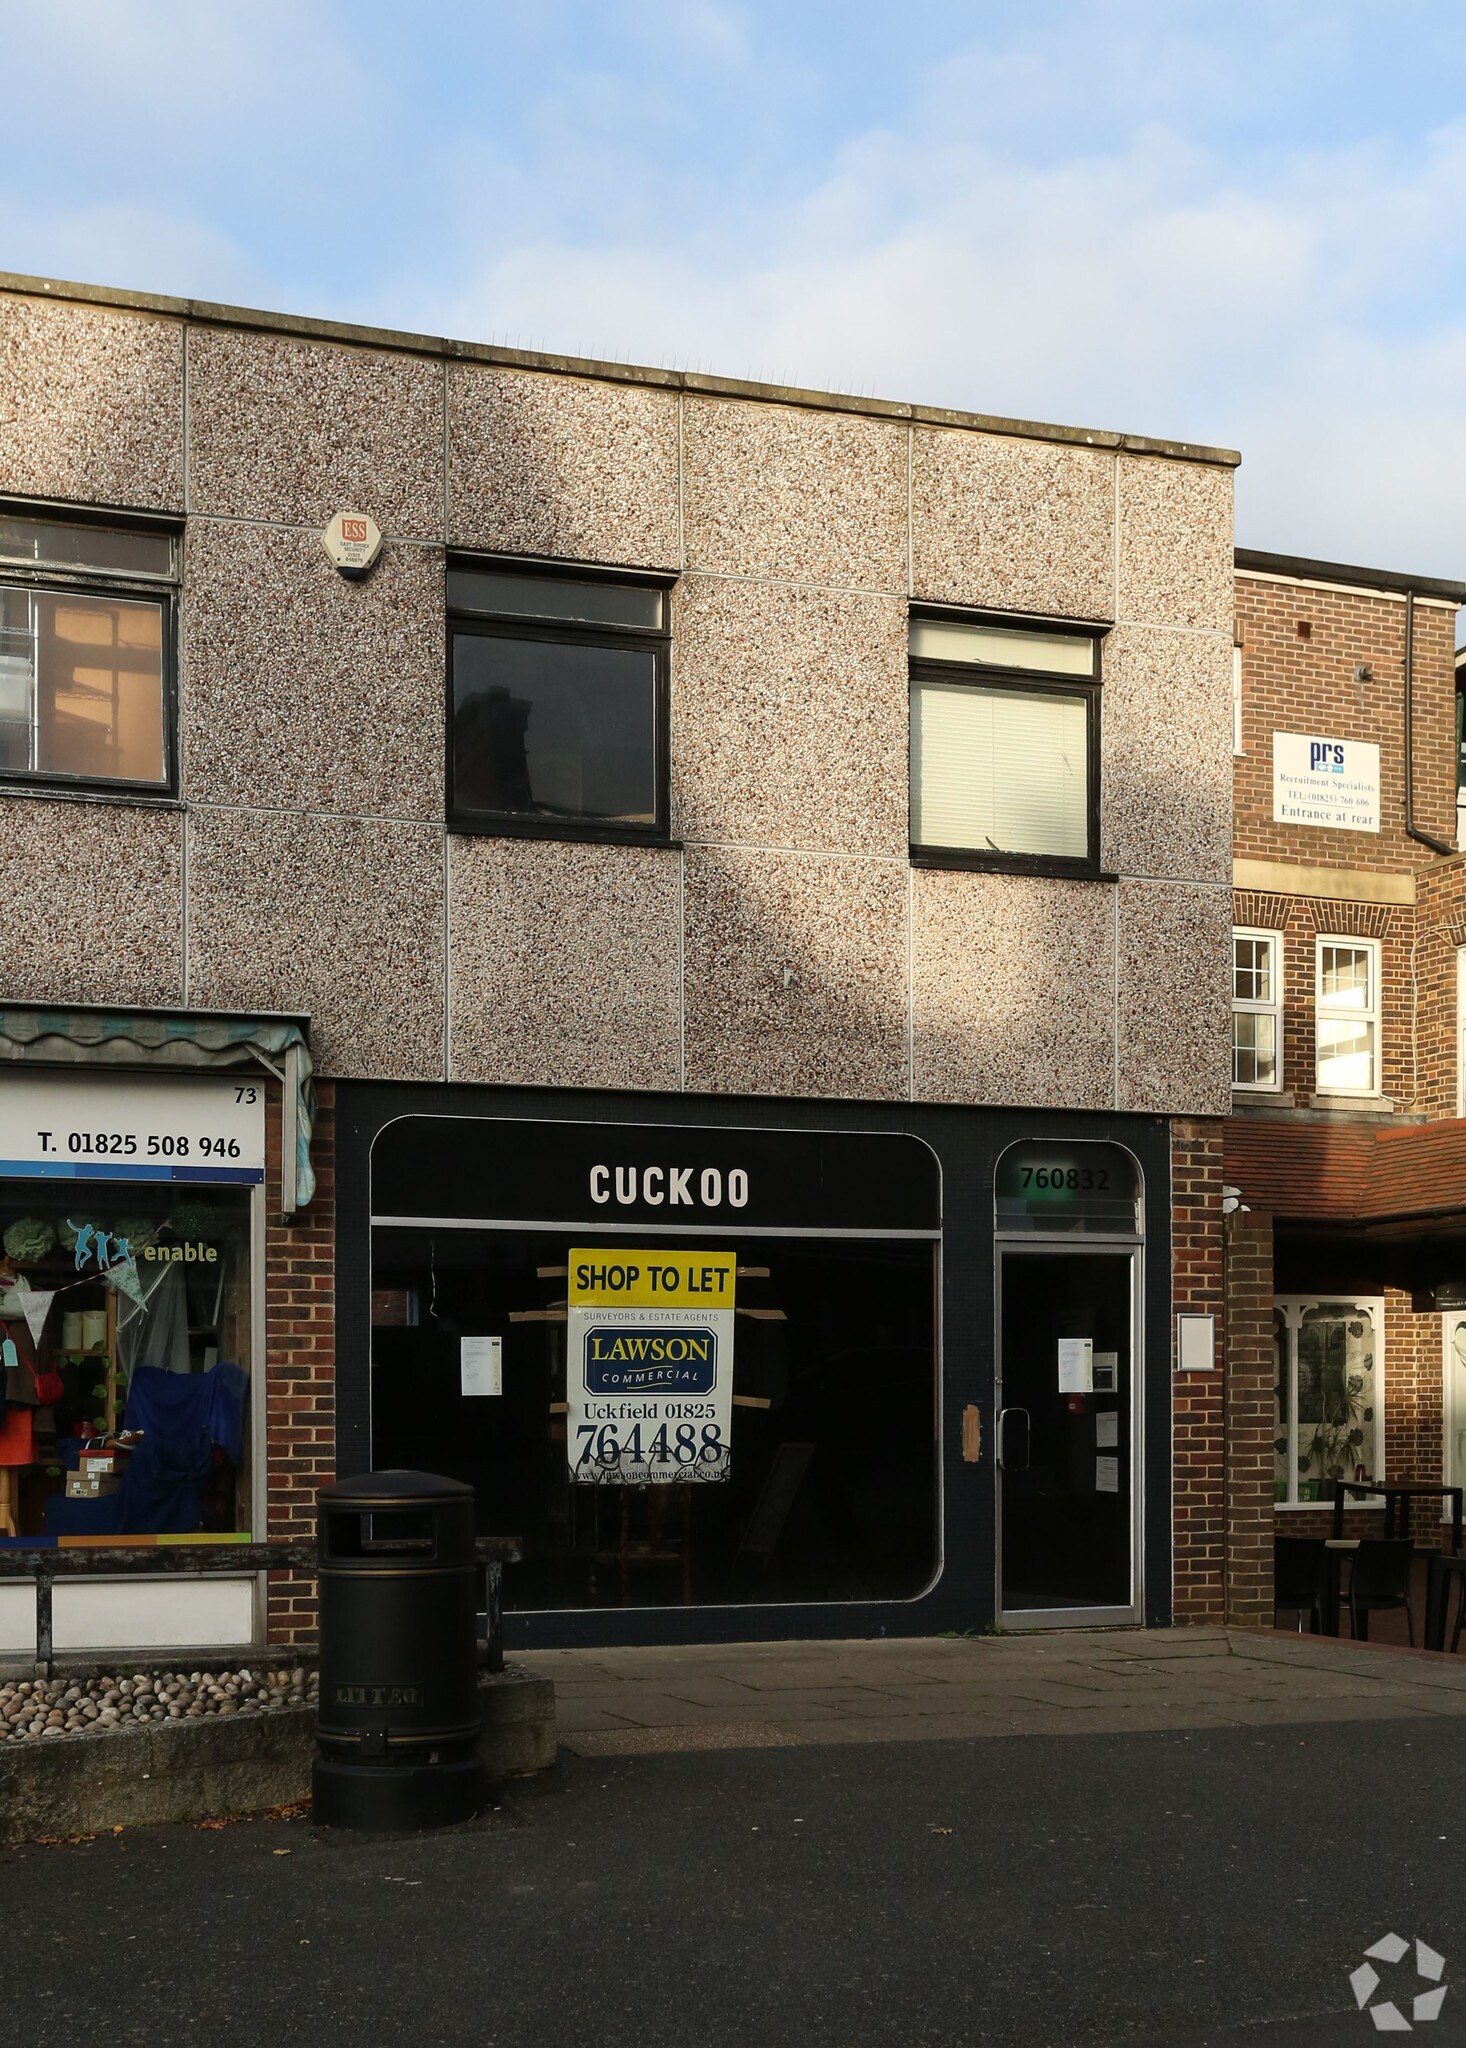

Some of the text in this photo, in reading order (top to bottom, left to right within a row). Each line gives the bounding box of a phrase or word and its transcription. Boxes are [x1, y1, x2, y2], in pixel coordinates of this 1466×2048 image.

[344, 522, 365, 539] ESS
[1310, 742, 1344, 771] prs
[1280, 773, 1375, 792] Recruitment Specialists
[1341, 796, 1354, 805] 760
[1281, 805, 1374, 825] Entrance at rear
[233, 1087, 258, 1105] 73
[37, 1132, 242, 1159] T. 01825 508 946
[590, 1164, 750, 1208] CUCKOO
[1020, 1167, 1110, 1191] 760832
[144, 1242, 218, 1263] enable
[576, 1265, 730, 1293] SHOP TO LET
[583, 1312, 719, 1322] SURVEYORS & ESTATE AGENTS
[591, 1338, 710, 1361] LAWSON
[601, 1369, 699, 1384] COMMERCIAL
[584, 1403, 716, 1419] Uckfield 01825
[576, 1423, 722, 1465] 764488
[575, 1468, 725, 1480] www.lawsoncommercial.co.u
[336, 1687, 418, 1705] LITTER
